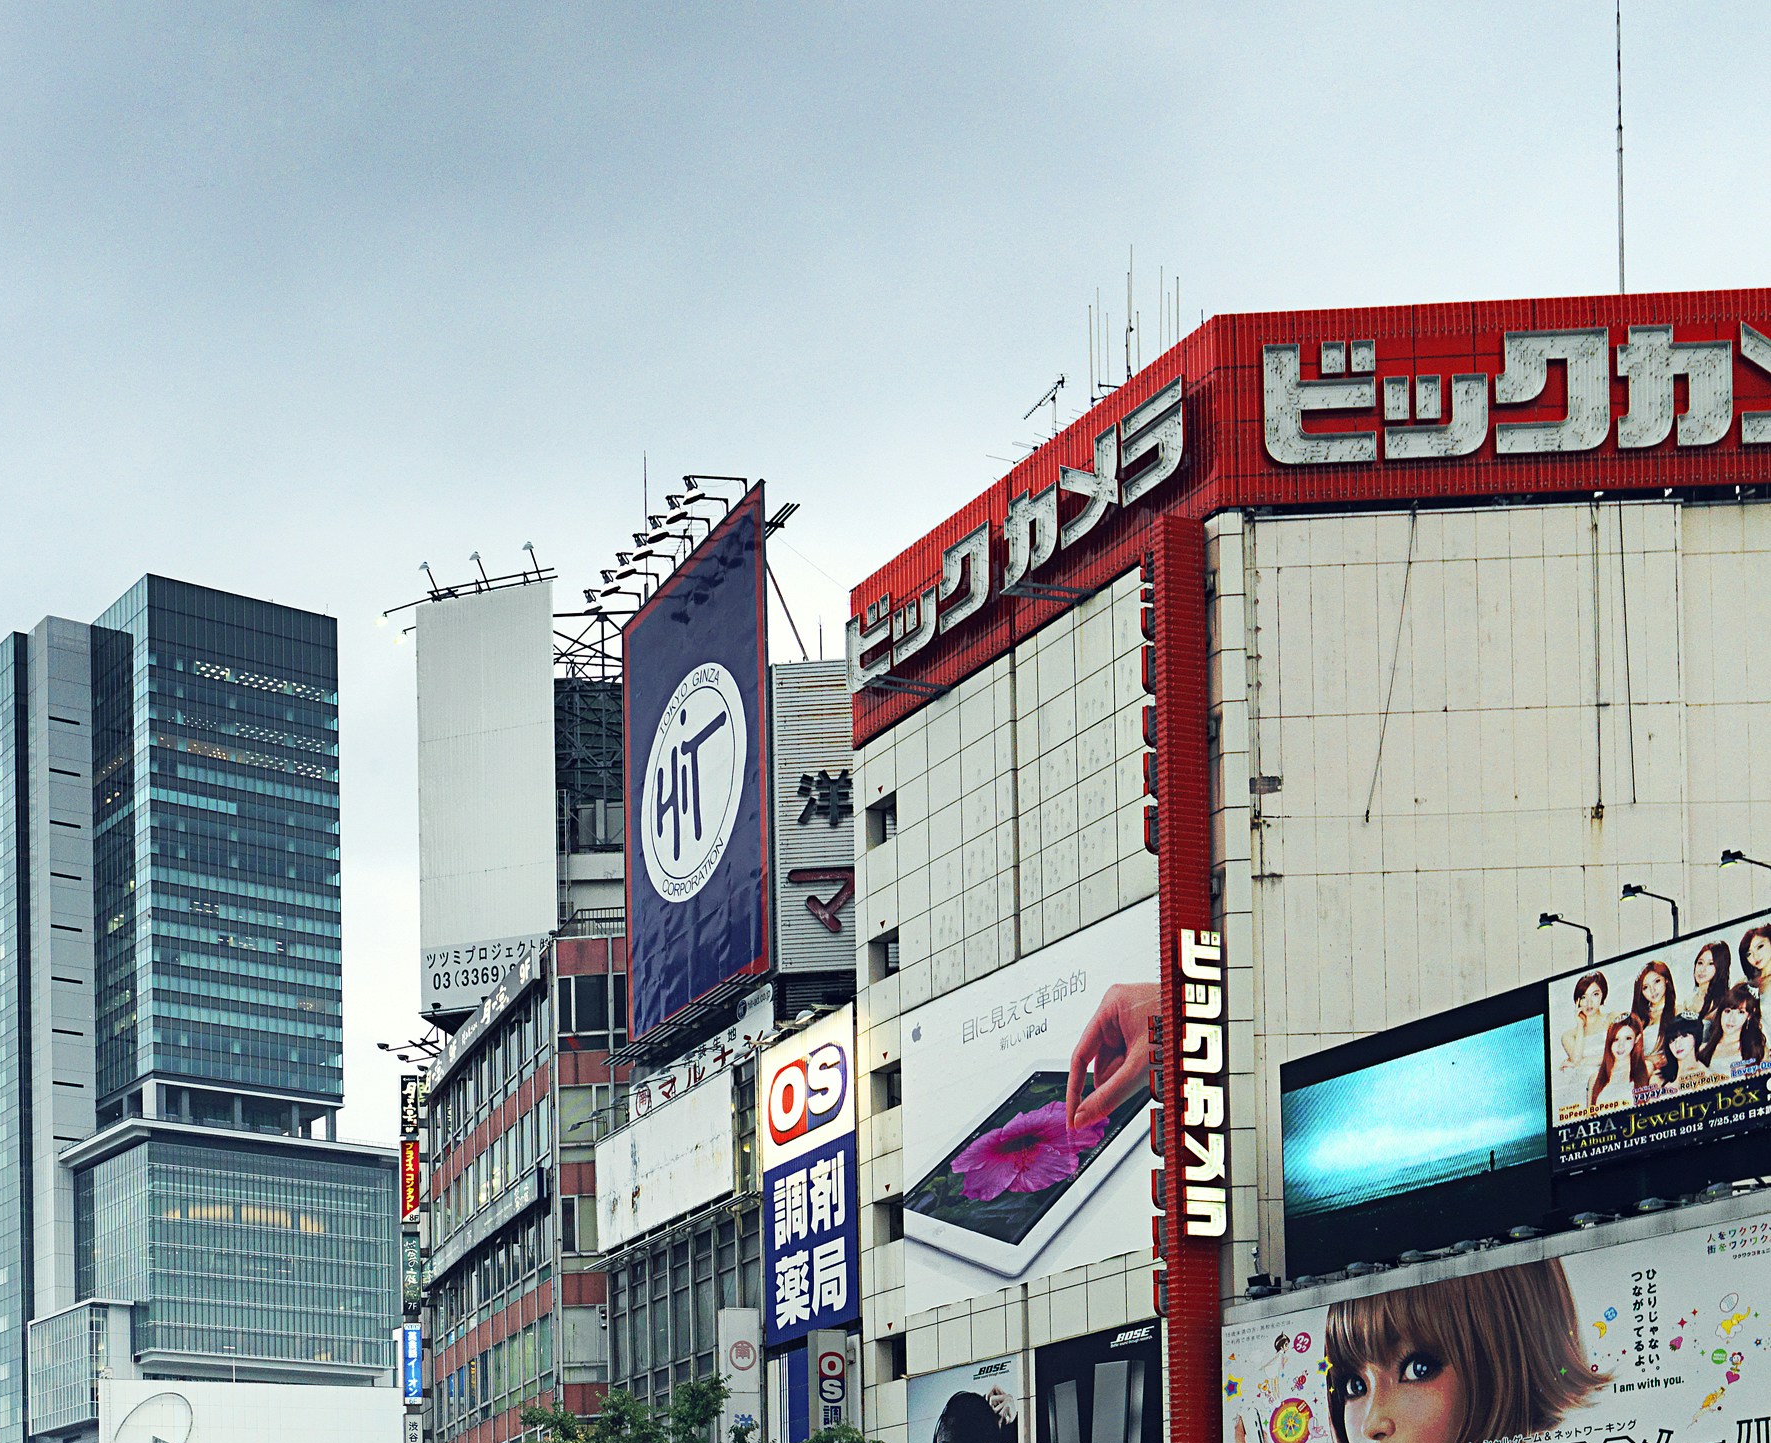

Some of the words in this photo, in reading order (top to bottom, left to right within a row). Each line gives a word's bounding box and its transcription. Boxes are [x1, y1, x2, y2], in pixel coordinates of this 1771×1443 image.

[844, 374, 1185, 695] ビックカメラ
[659, 682, 689, 736] TOKYO
[692, 670, 720, 688] GINZA
[661, 836, 726, 897] CORPORATION
[519, 957, 531, 984] 9F
[961, 968, 1087, 1045] 目に見えて革命的
[658, 1030, 764, 1100] マルナン
[771, 1044, 847, 1132] OS
[1179, 927, 1228, 1238] ビックカメラ
[1558, 1117, 1617, 1144] T-ARA
[1622, 1099, 1712, 1138] Jewelry
[1716, 1086, 1761, 1111] box
[1559, 1109, 1588, 1121] BoPeep
[1589, 1101, 1619, 1114] BoPeep
[1559, 1151, 1589, 1164] T-ARA
[1590, 1144, 1622, 1158] JAPAN
[1624, 1136, 1648, 1149] LIVE
[1649, 1128, 1678, 1142] TOUR
[1679, 1121, 1705, 1136] 2012
[1708, 1111, 1747, 1128] 7/25,26
[1561, 1141, 1576, 1153] 1st
[1580, 1134, 1617, 1148] Album
[408, 1214, 419, 1222] 8F
[773, 1150, 847, 1251] 調剤
[408, 1303, 418, 1311] 7F
[775, 1237, 848, 1331] 薬局
[1110, 1325, 1155, 1345] BOSE
[1631, 1271, 1646, 1373] つながってるよ。
[1646, 1268, 1661, 1371] ひとりじゃない。
[820, 1352, 845, 1400] OS
[977, 1361, 1011, 1377] BOSE
[1613, 1383, 1618, 1394] I
[1619, 1382, 1635, 1394] am
[1637, 1378, 1661, 1391] with
[1663, 1376, 1685, 1389] you.
